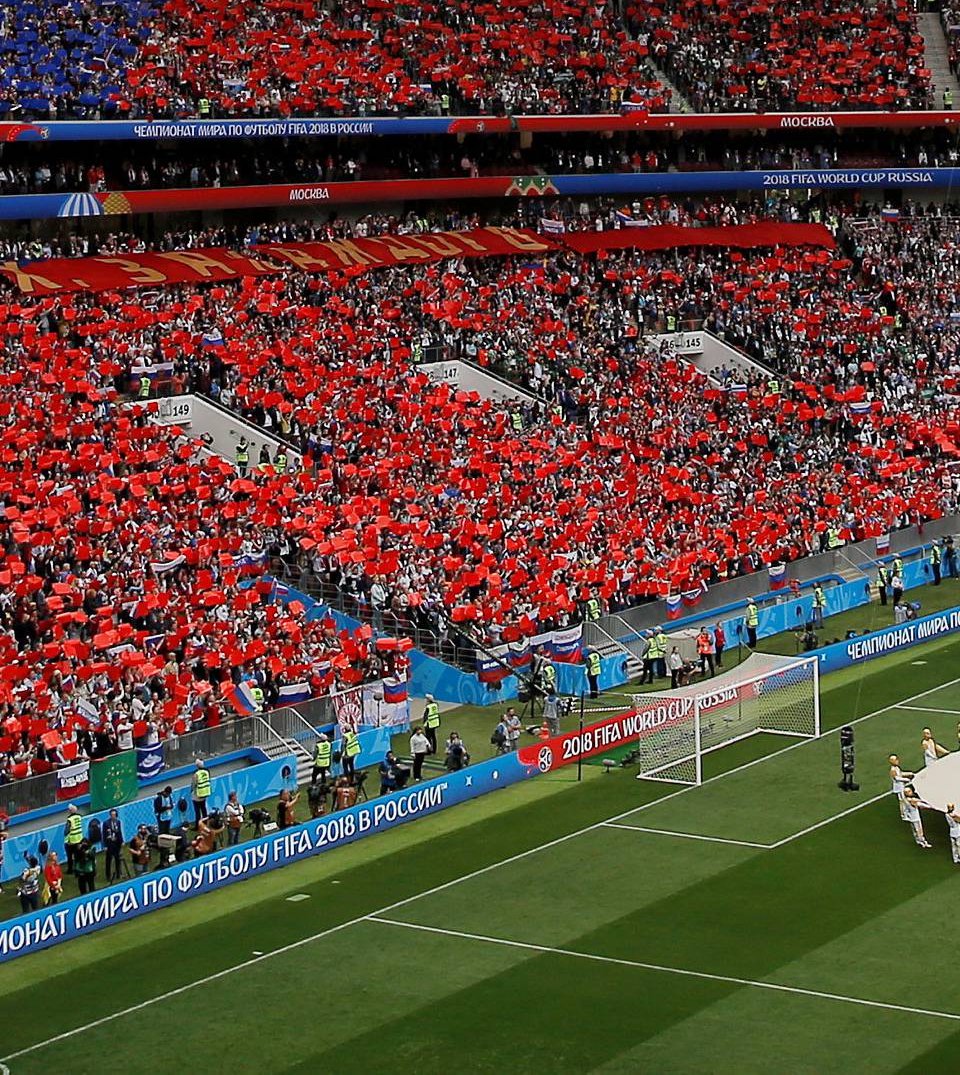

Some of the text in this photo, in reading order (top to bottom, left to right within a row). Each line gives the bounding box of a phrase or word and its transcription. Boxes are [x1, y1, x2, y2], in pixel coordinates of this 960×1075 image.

[780, 116, 834, 127] МОСКВА
[134, 125, 197, 137] ЧЕМПИОНАТ
[198, 125, 227, 136] МИРА
[228, 124, 242, 136] ПО
[244, 123, 286, 135] ФУТБОЛУ
[288, 123, 307, 134] FIFA
[309, 123, 329, 134] 2018
[337, 122, 373, 134] РОССИИ
[763, 175, 789, 185] 2018
[791, 174, 816, 185] FIFA
[818, 174, 859, 184] WORLD
[861, 173, 886, 184] CUP
[289, 187, 329, 200] МОСКВА
[686, 338, 701, 348] 145
[173, 404, 190, 416] 149
[847, 626, 916, 659] ЧЕМПИОНАТ
[918, 615, 948, 639] МИРА
[563, 732, 592, 759] 2018
[594, 722, 621, 748] FIFA
[622, 705, 666, 737] WORLD
[668, 696, 693, 720] CUP
[75, 888, 138, 929] МИРА
[143, 876, 172, 906] ПО
[178, 843, 268, 892] ФУТБОЛУ
[273, 830, 312, 862] FIFA
[316, 814, 355, 847] 2018
[359, 809, 371, 832] В
